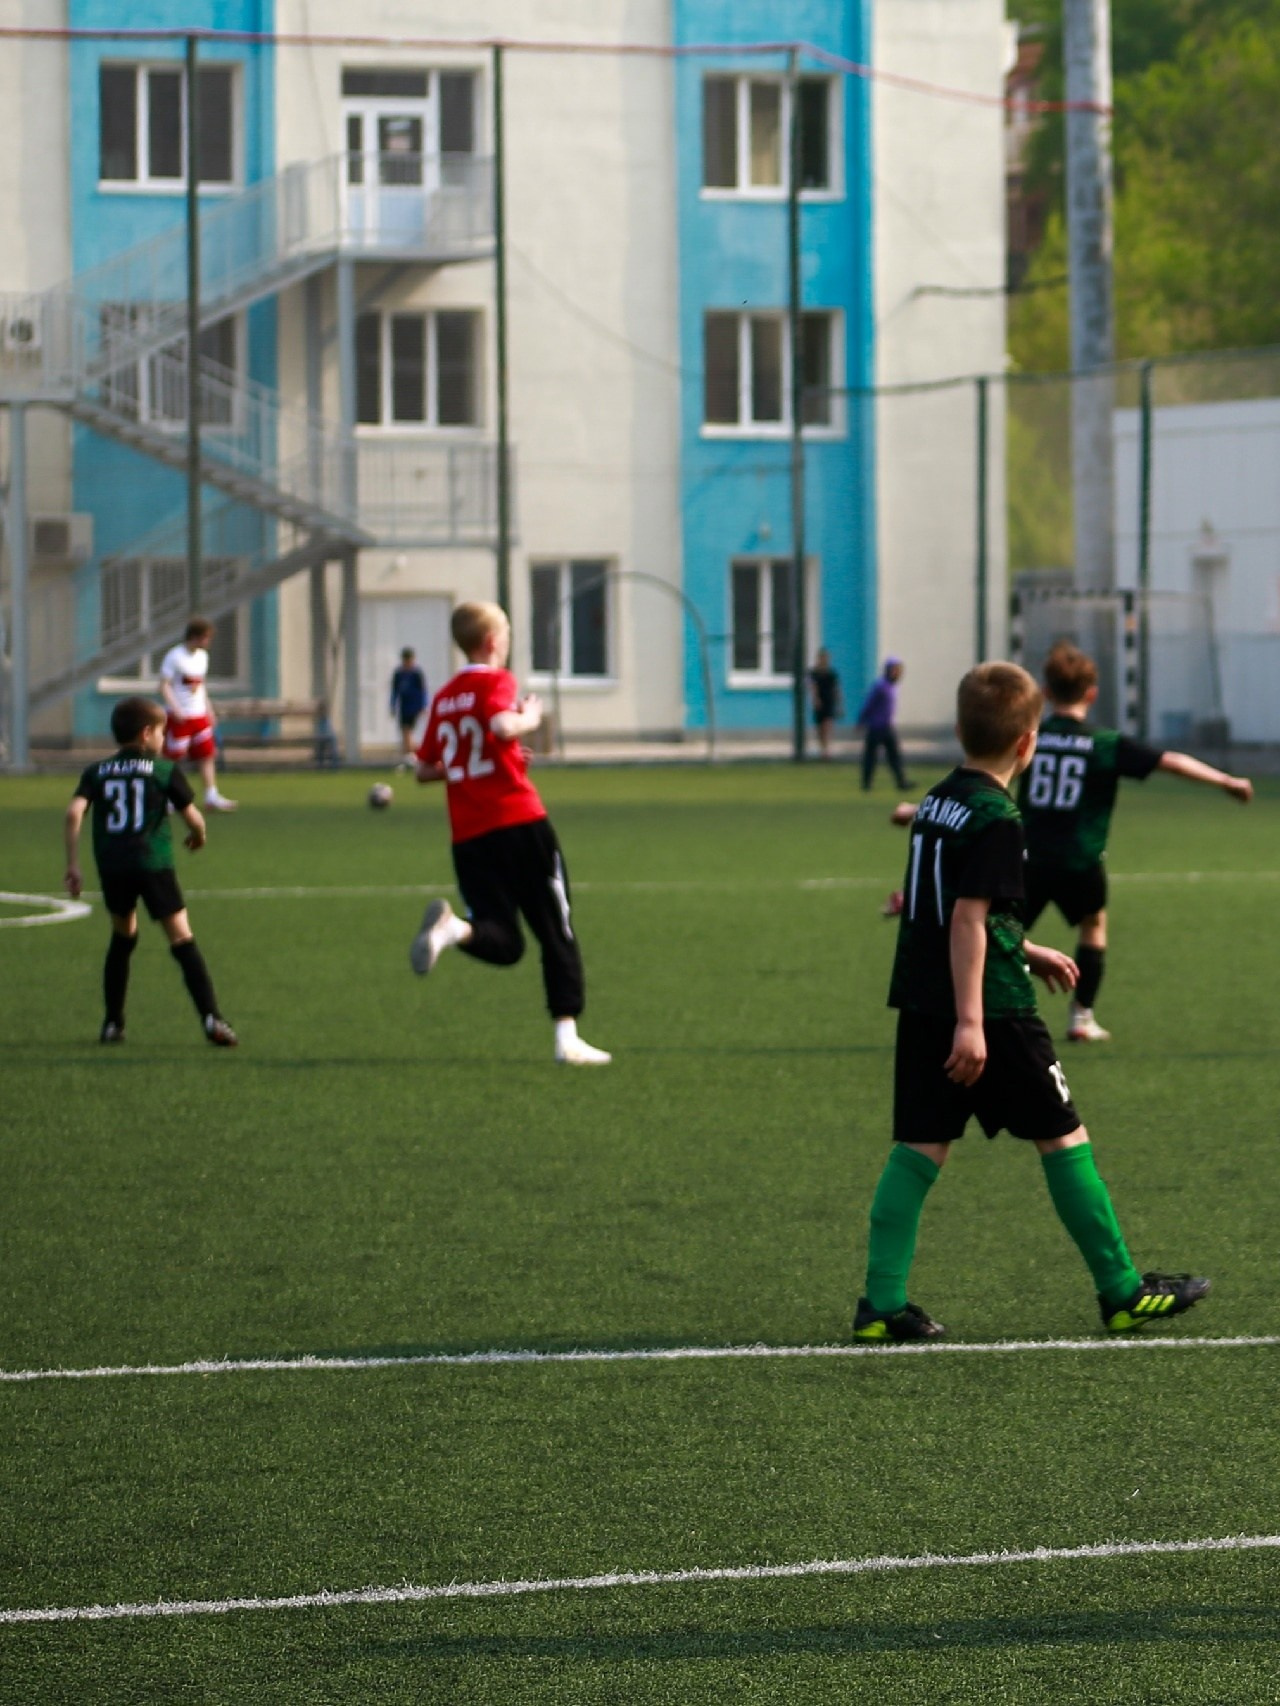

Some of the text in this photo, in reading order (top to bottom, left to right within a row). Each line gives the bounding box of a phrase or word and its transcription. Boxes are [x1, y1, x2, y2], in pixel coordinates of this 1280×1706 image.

[437, 715, 496, 783] 22
[104, 777, 145, 832] 31
[1029, 753, 1087, 809] 66
